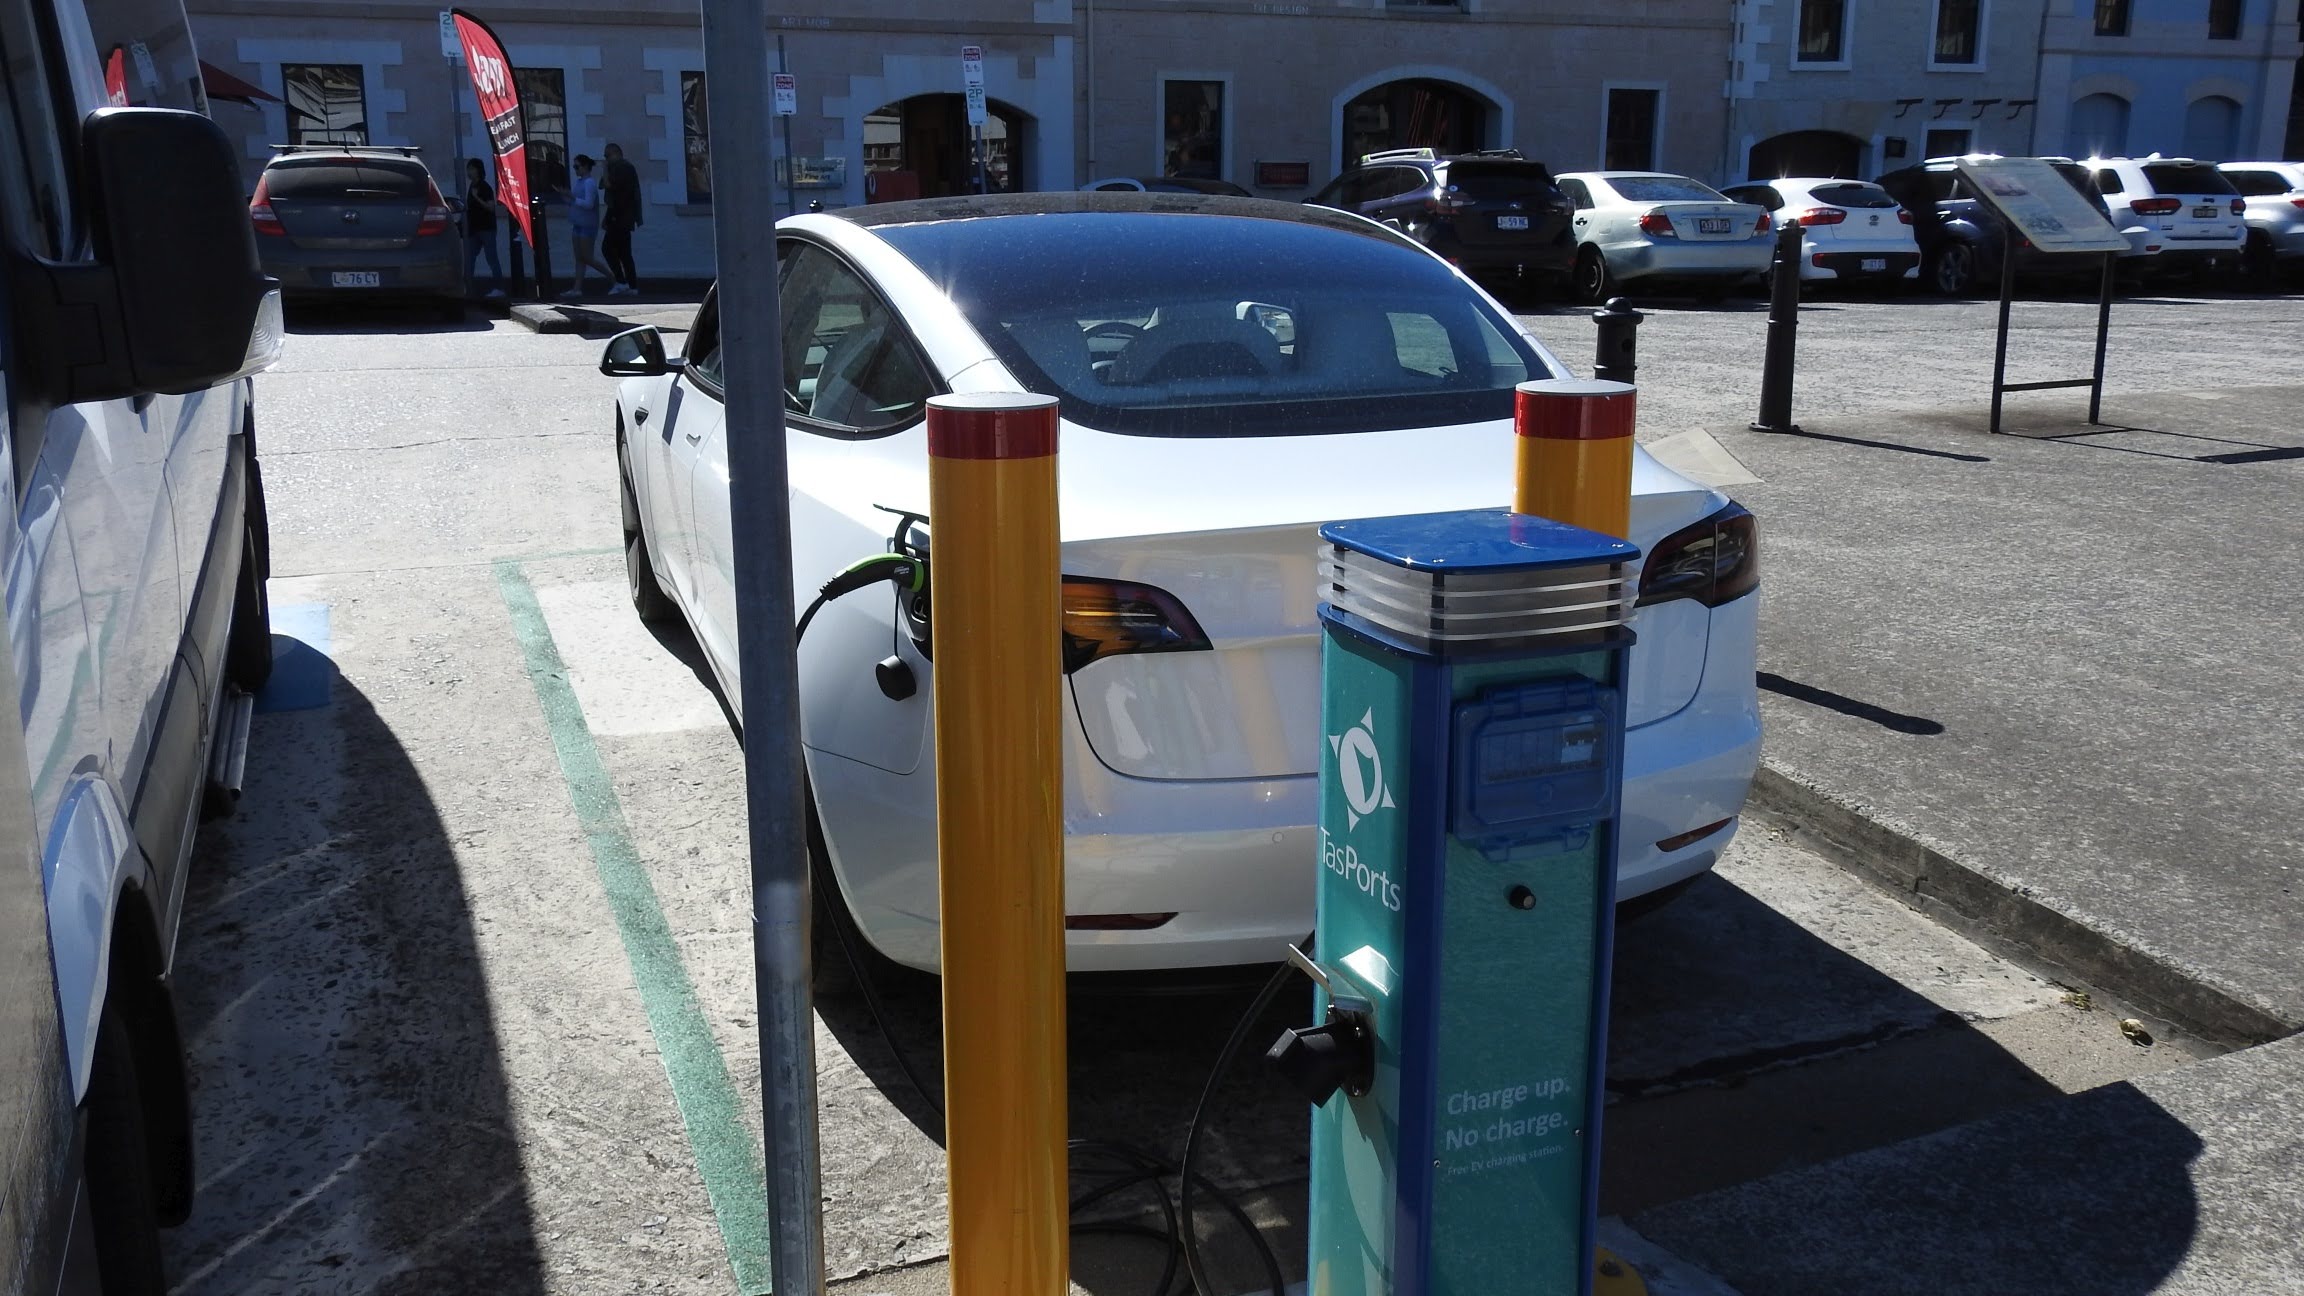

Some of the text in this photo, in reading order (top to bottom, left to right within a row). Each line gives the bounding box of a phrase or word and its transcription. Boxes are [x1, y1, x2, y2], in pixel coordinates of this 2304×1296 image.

[968, 88, 983, 98] 2P
[1320, 826, 1401, 912] TasPorts
[1447, 1077, 1571, 1115] Charge up.
[1445, 1111, 1569, 1151] No charge.
[1447, 1166, 1469, 1176] Free
[1471, 1161, 1484, 1172] EV
[1486, 1153, 1527, 1169] charging
